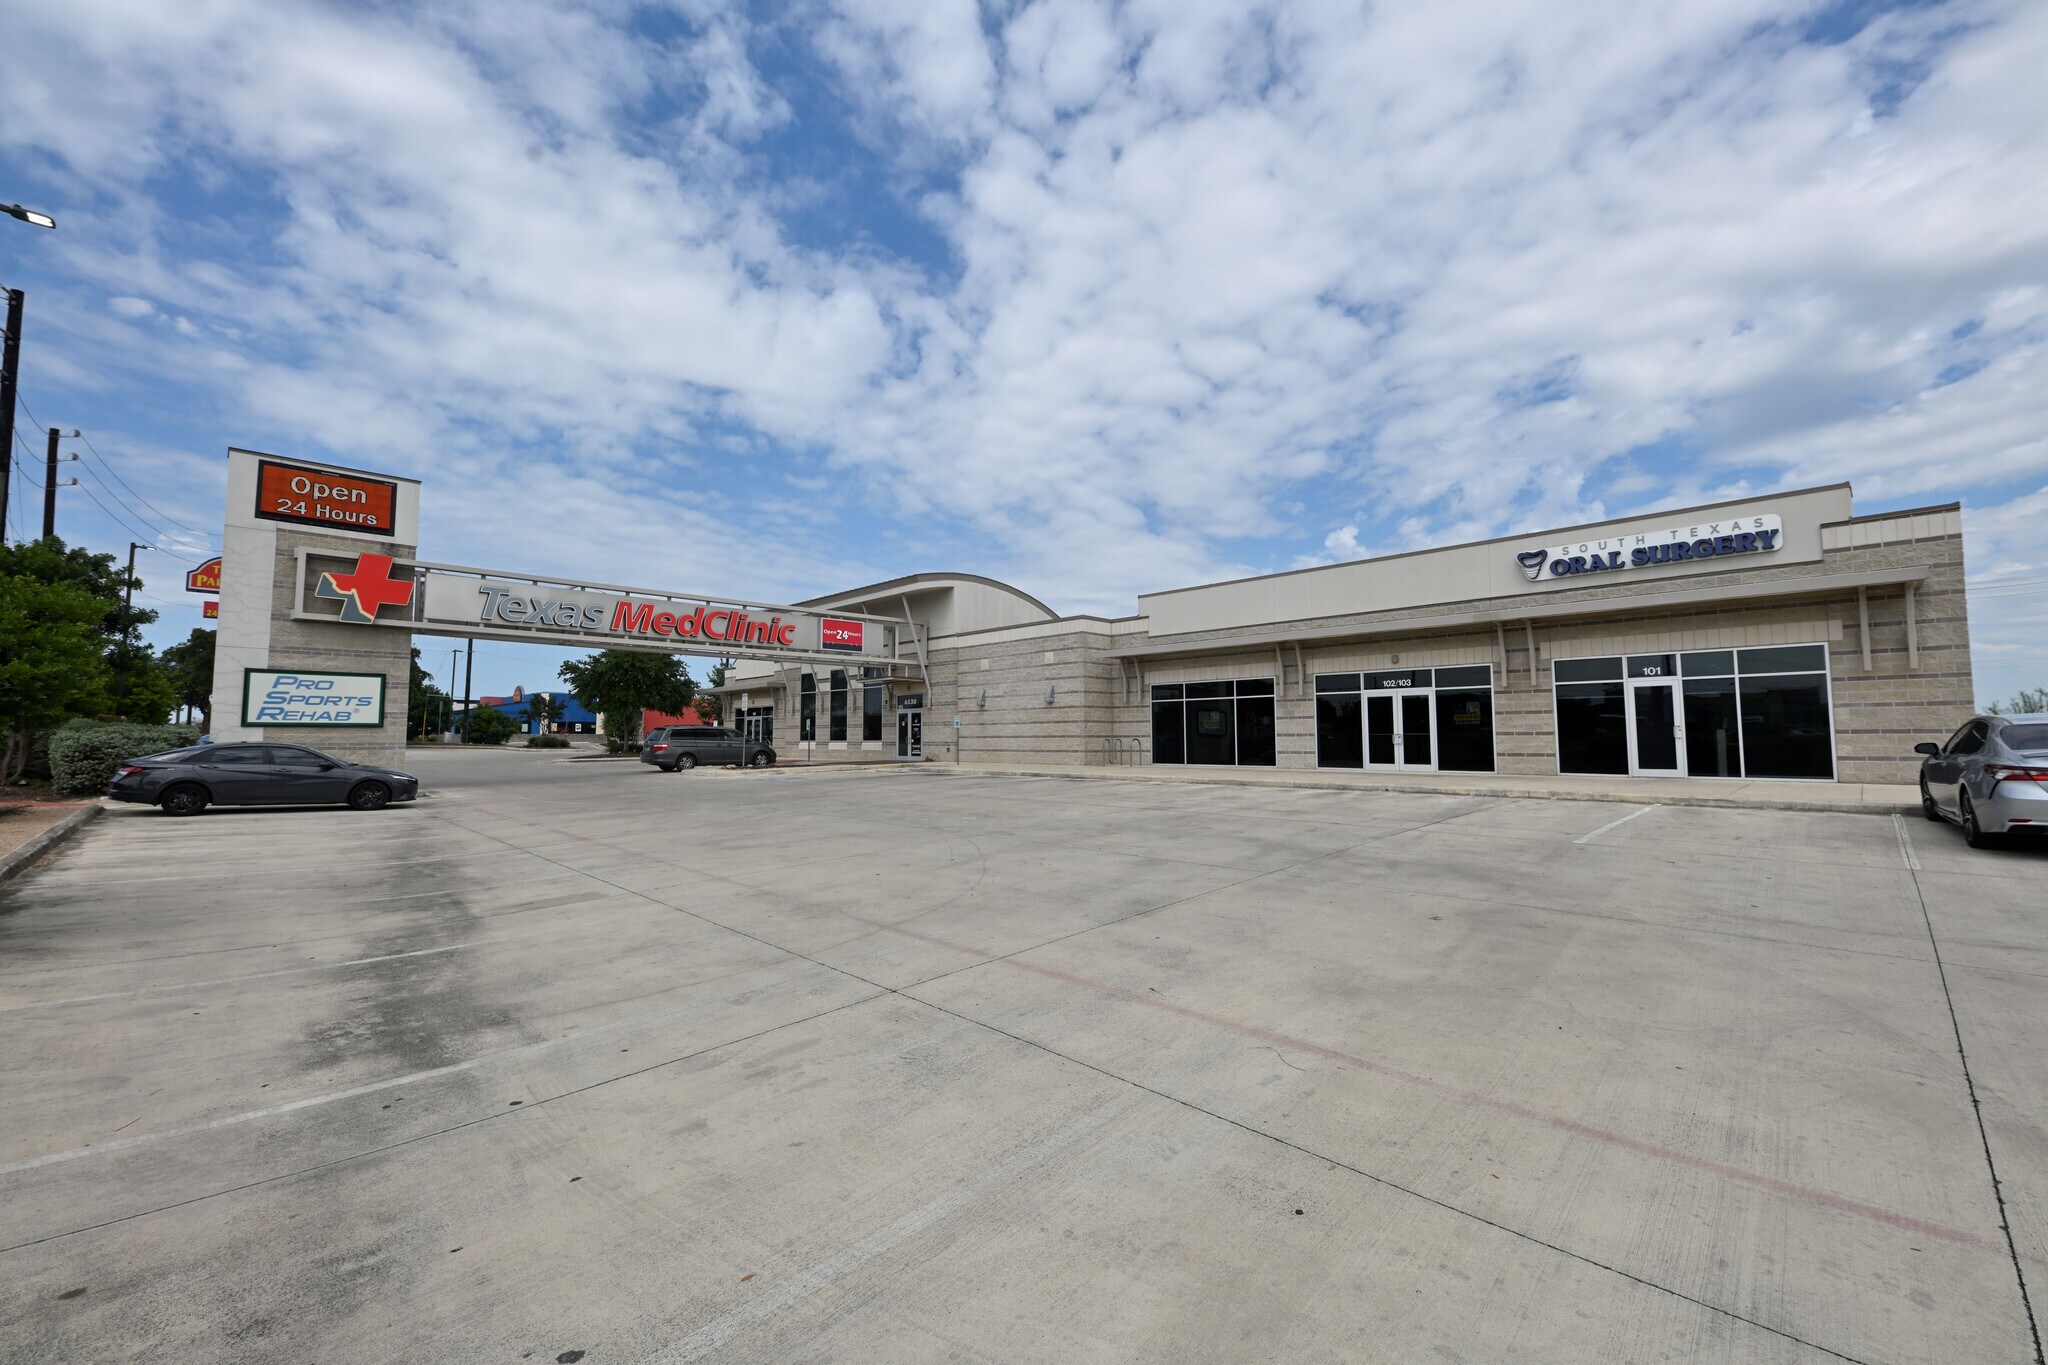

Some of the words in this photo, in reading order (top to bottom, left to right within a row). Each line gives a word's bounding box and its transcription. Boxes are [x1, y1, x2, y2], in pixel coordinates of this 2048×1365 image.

[291, 476, 367, 504] Open
[276, 498, 308, 515] 24
[316, 503, 378, 525] Hours
[1562, 535, 1645, 556] SOUTH
[1670, 518, 1764, 540] TEXAS
[1550, 551, 1625, 576] ORAL
[1631, 529, 1779, 566] SURGERY
[480, 585, 605, 629] Texas
[612, 600, 796, 646] MedClinic
[836, 629, 849, 640] 24
[1382, 679, 1412, 688] 102/103
[1642, 666, 1661, 675] 101
